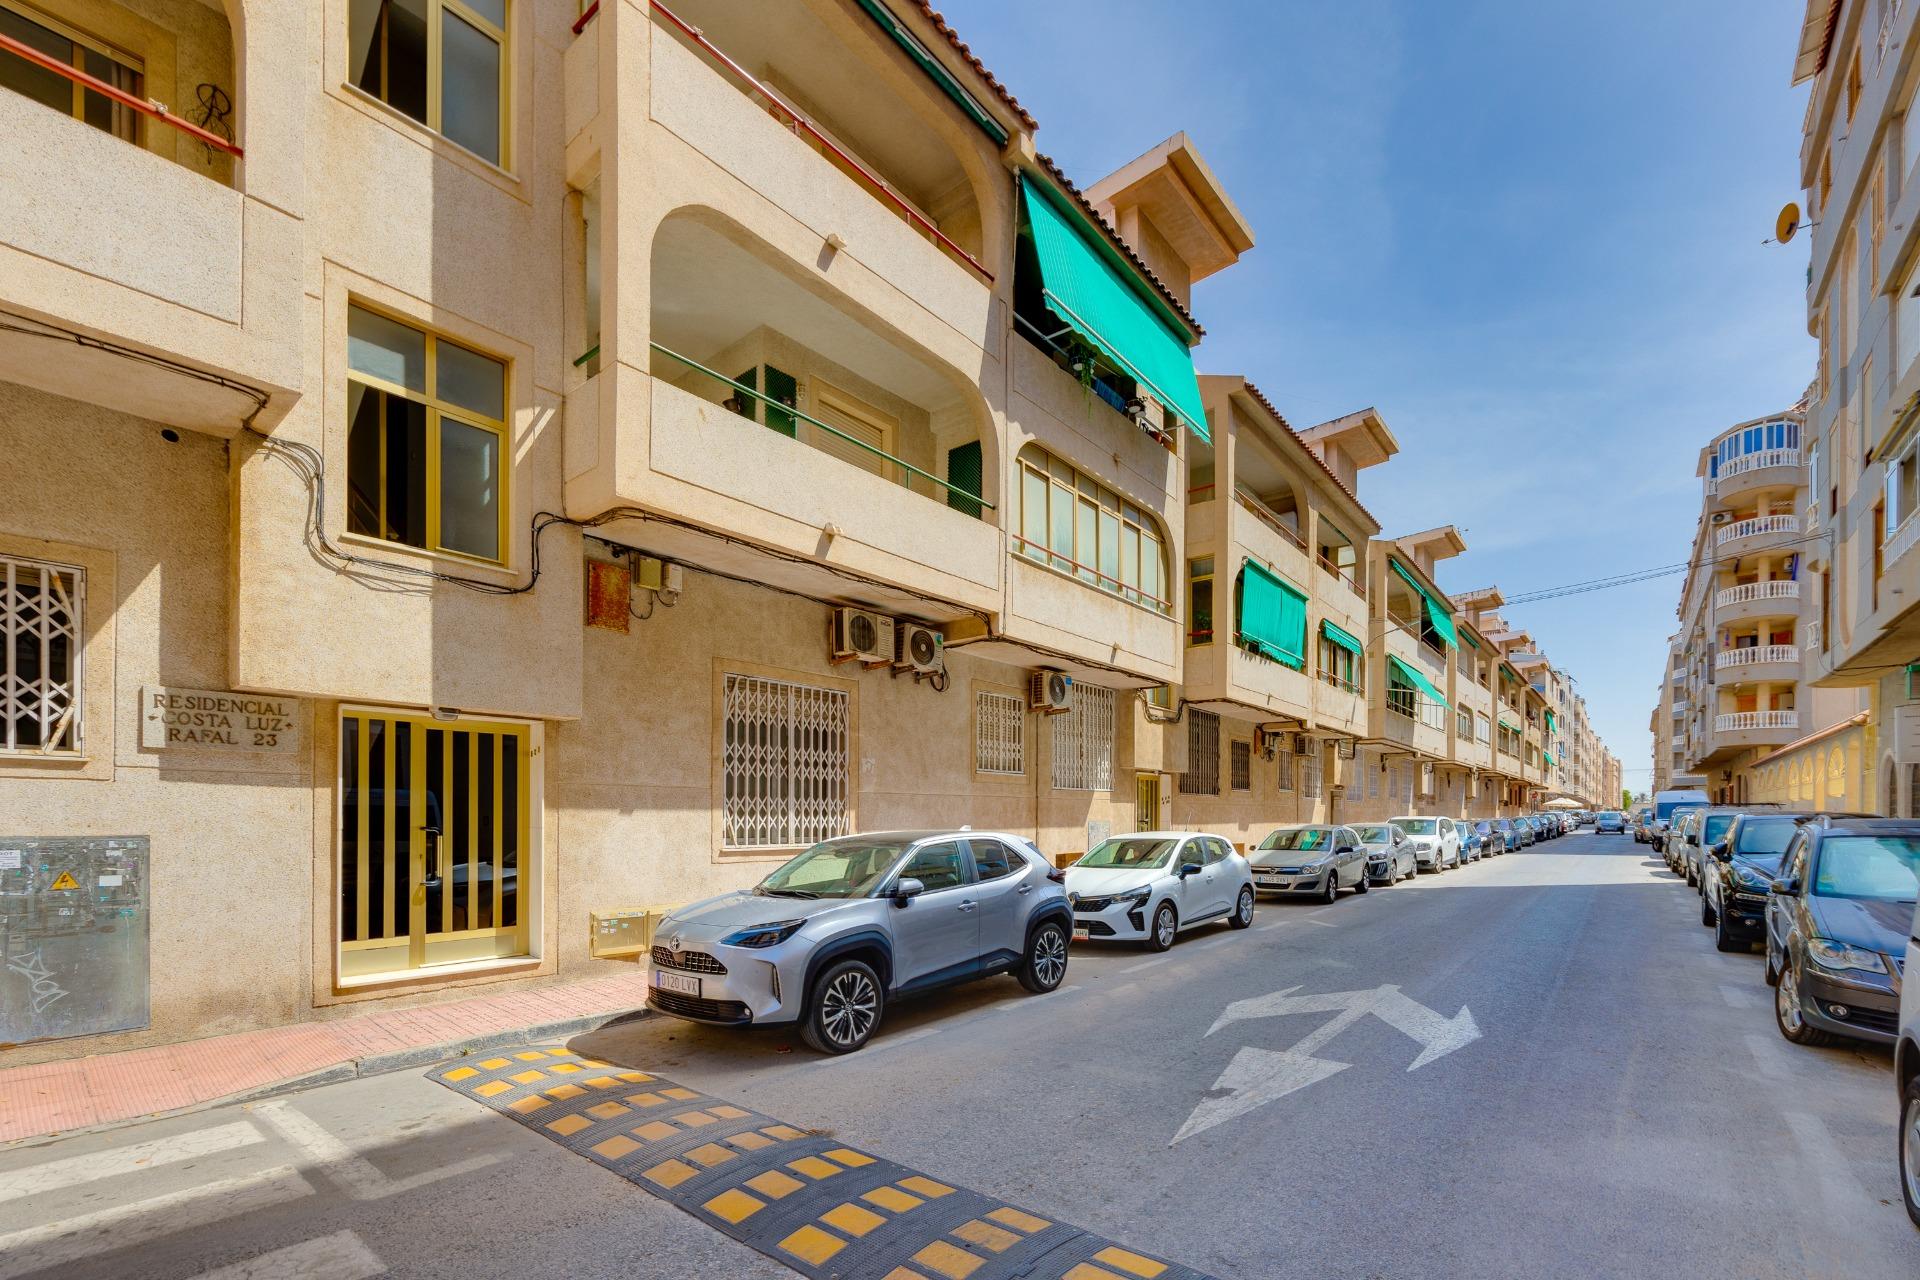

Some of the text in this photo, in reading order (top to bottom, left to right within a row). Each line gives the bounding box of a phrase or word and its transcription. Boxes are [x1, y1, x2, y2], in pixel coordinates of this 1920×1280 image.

[153, 693, 290, 717] RESIDENCIAL
[161, 710, 283, 732] COSTA LUZ
[168, 727, 278, 747] RAFAL 23
[681, 978, 698, 993] LVX
